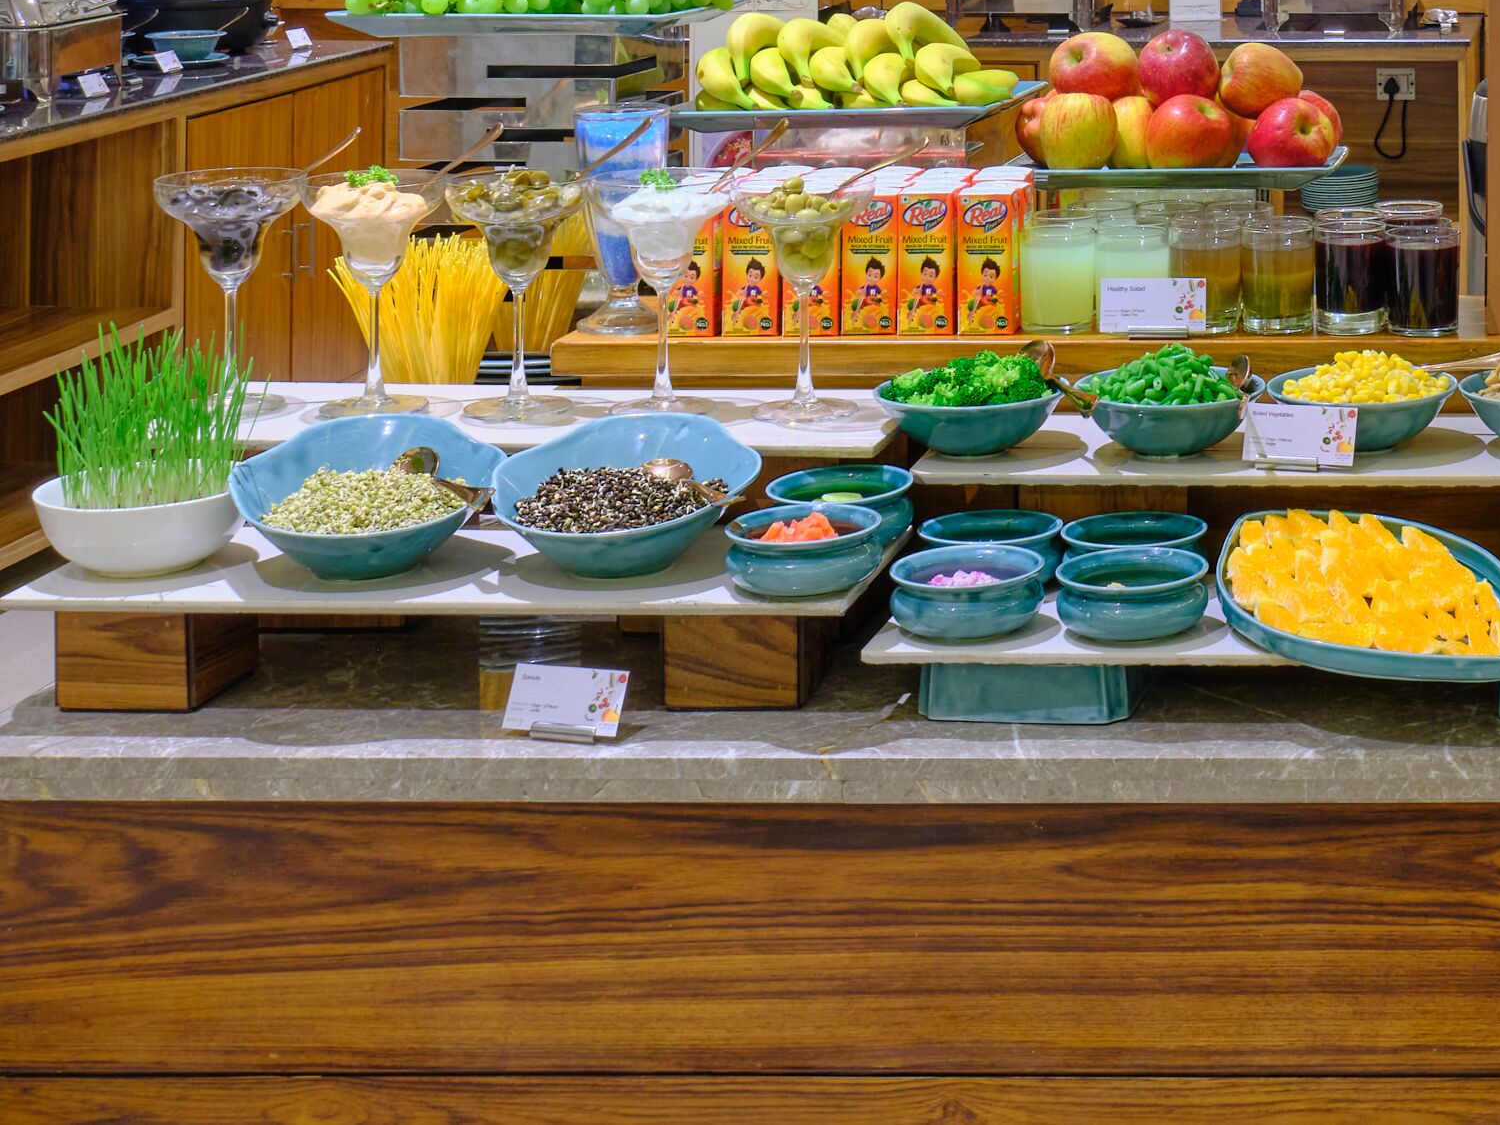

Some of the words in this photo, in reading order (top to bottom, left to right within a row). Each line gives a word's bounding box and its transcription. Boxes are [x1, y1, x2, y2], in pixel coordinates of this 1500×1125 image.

[908, 201, 945, 226] Real
[967, 201, 1004, 228] Real
[694, 237, 708, 246] ruit
[727, 236, 753, 245] Mixed
[847, 235, 873, 244] Mixed
[875, 235, 893, 244] Fruit
[902, 235, 928, 244] Mixed
[929, 235, 948, 244] Fruit
[962, 235, 988, 245] Mixed
[990, 235, 1008, 245] Fruit
[1107, 285, 1128, 293] Healthy
